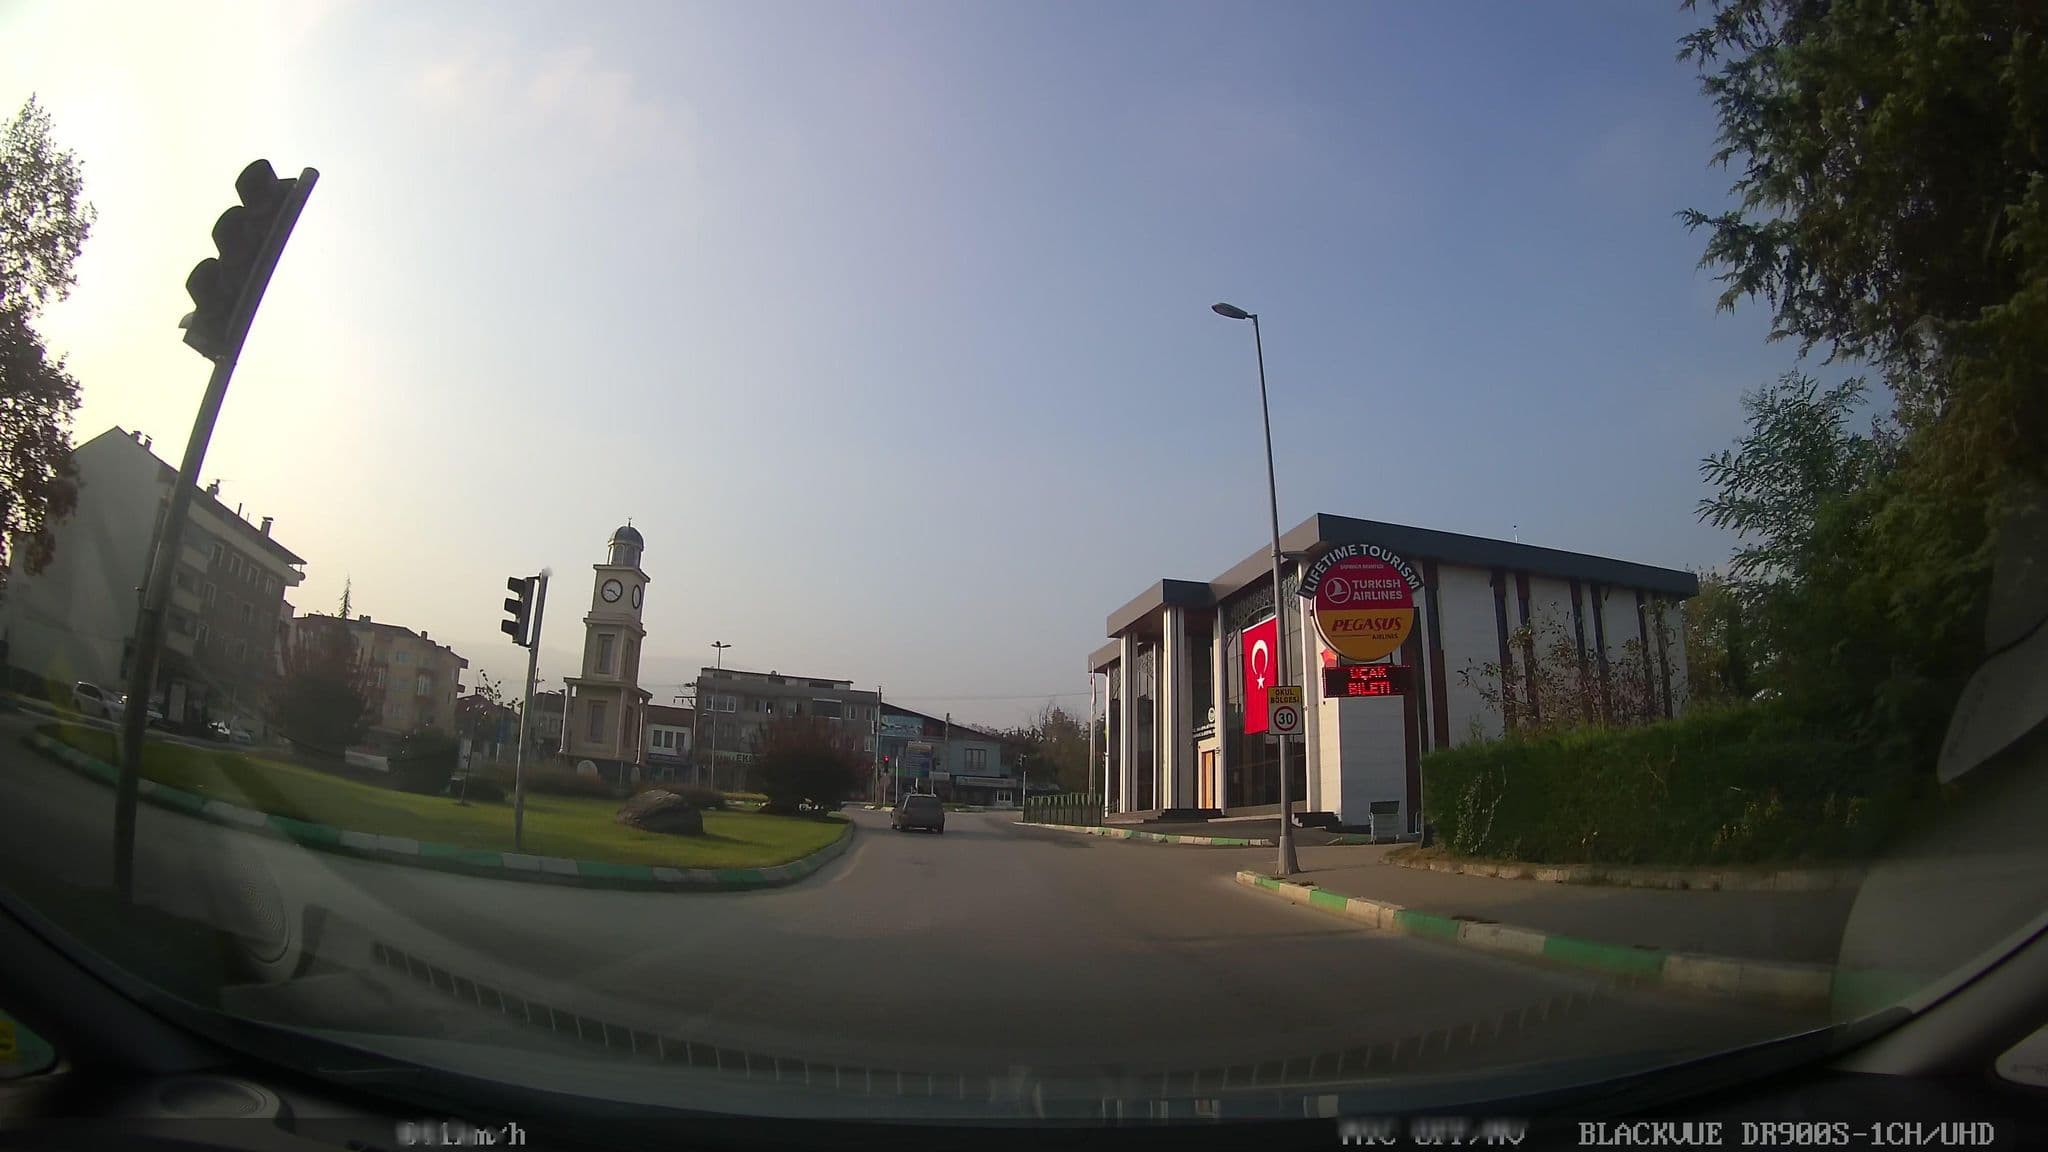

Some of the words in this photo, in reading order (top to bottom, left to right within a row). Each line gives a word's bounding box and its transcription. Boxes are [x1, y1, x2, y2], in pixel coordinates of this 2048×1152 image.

[1306, 545, 1358, 591] LIFETIME
[1360, 544, 1419, 590] TOURISM
[1352, 579, 1401, 590] TURKISH
[1352, 590, 1403, 601] AIRLINES
[1332, 617, 1402, 632] PEGASUS
[1278, 713, 1293, 725] 30
